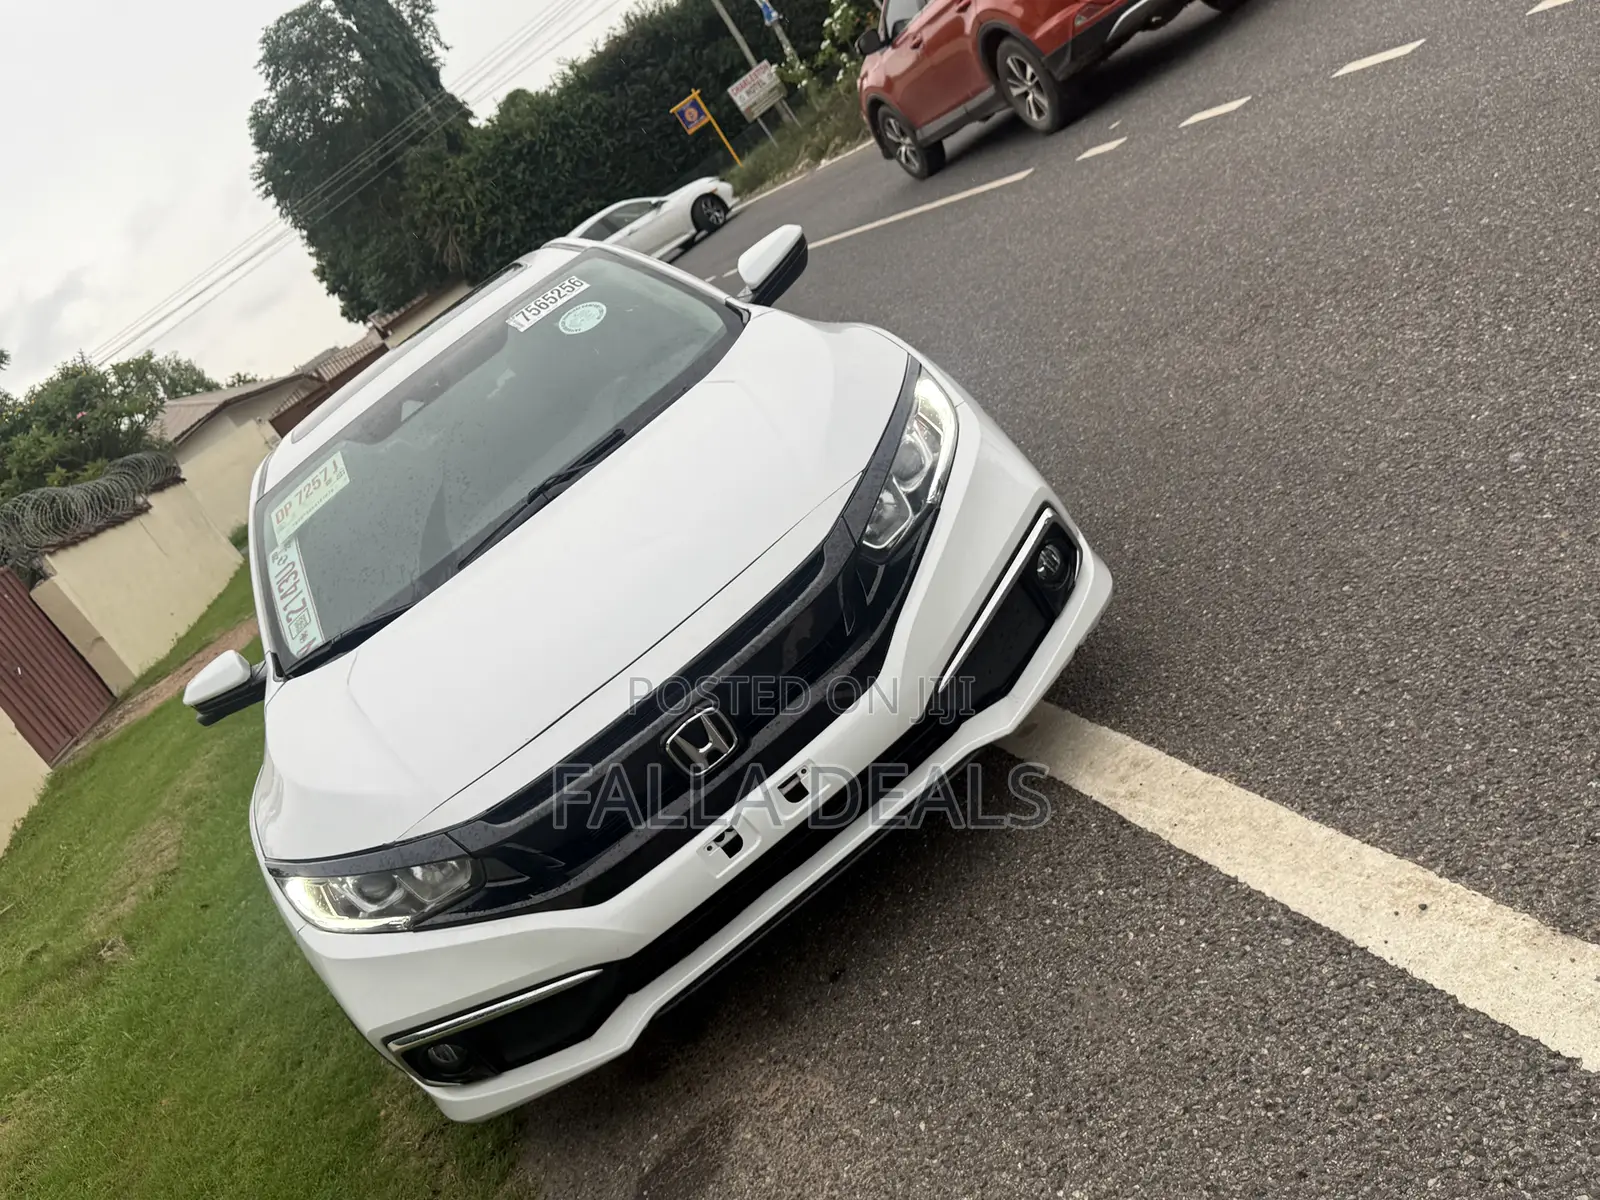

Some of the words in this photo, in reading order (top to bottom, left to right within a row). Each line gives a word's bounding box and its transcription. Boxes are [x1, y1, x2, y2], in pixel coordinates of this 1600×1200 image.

[515, 278, 585, 322] 7565256
[275, 501, 292, 525] DP
[294, 466, 328, 505] 7257
